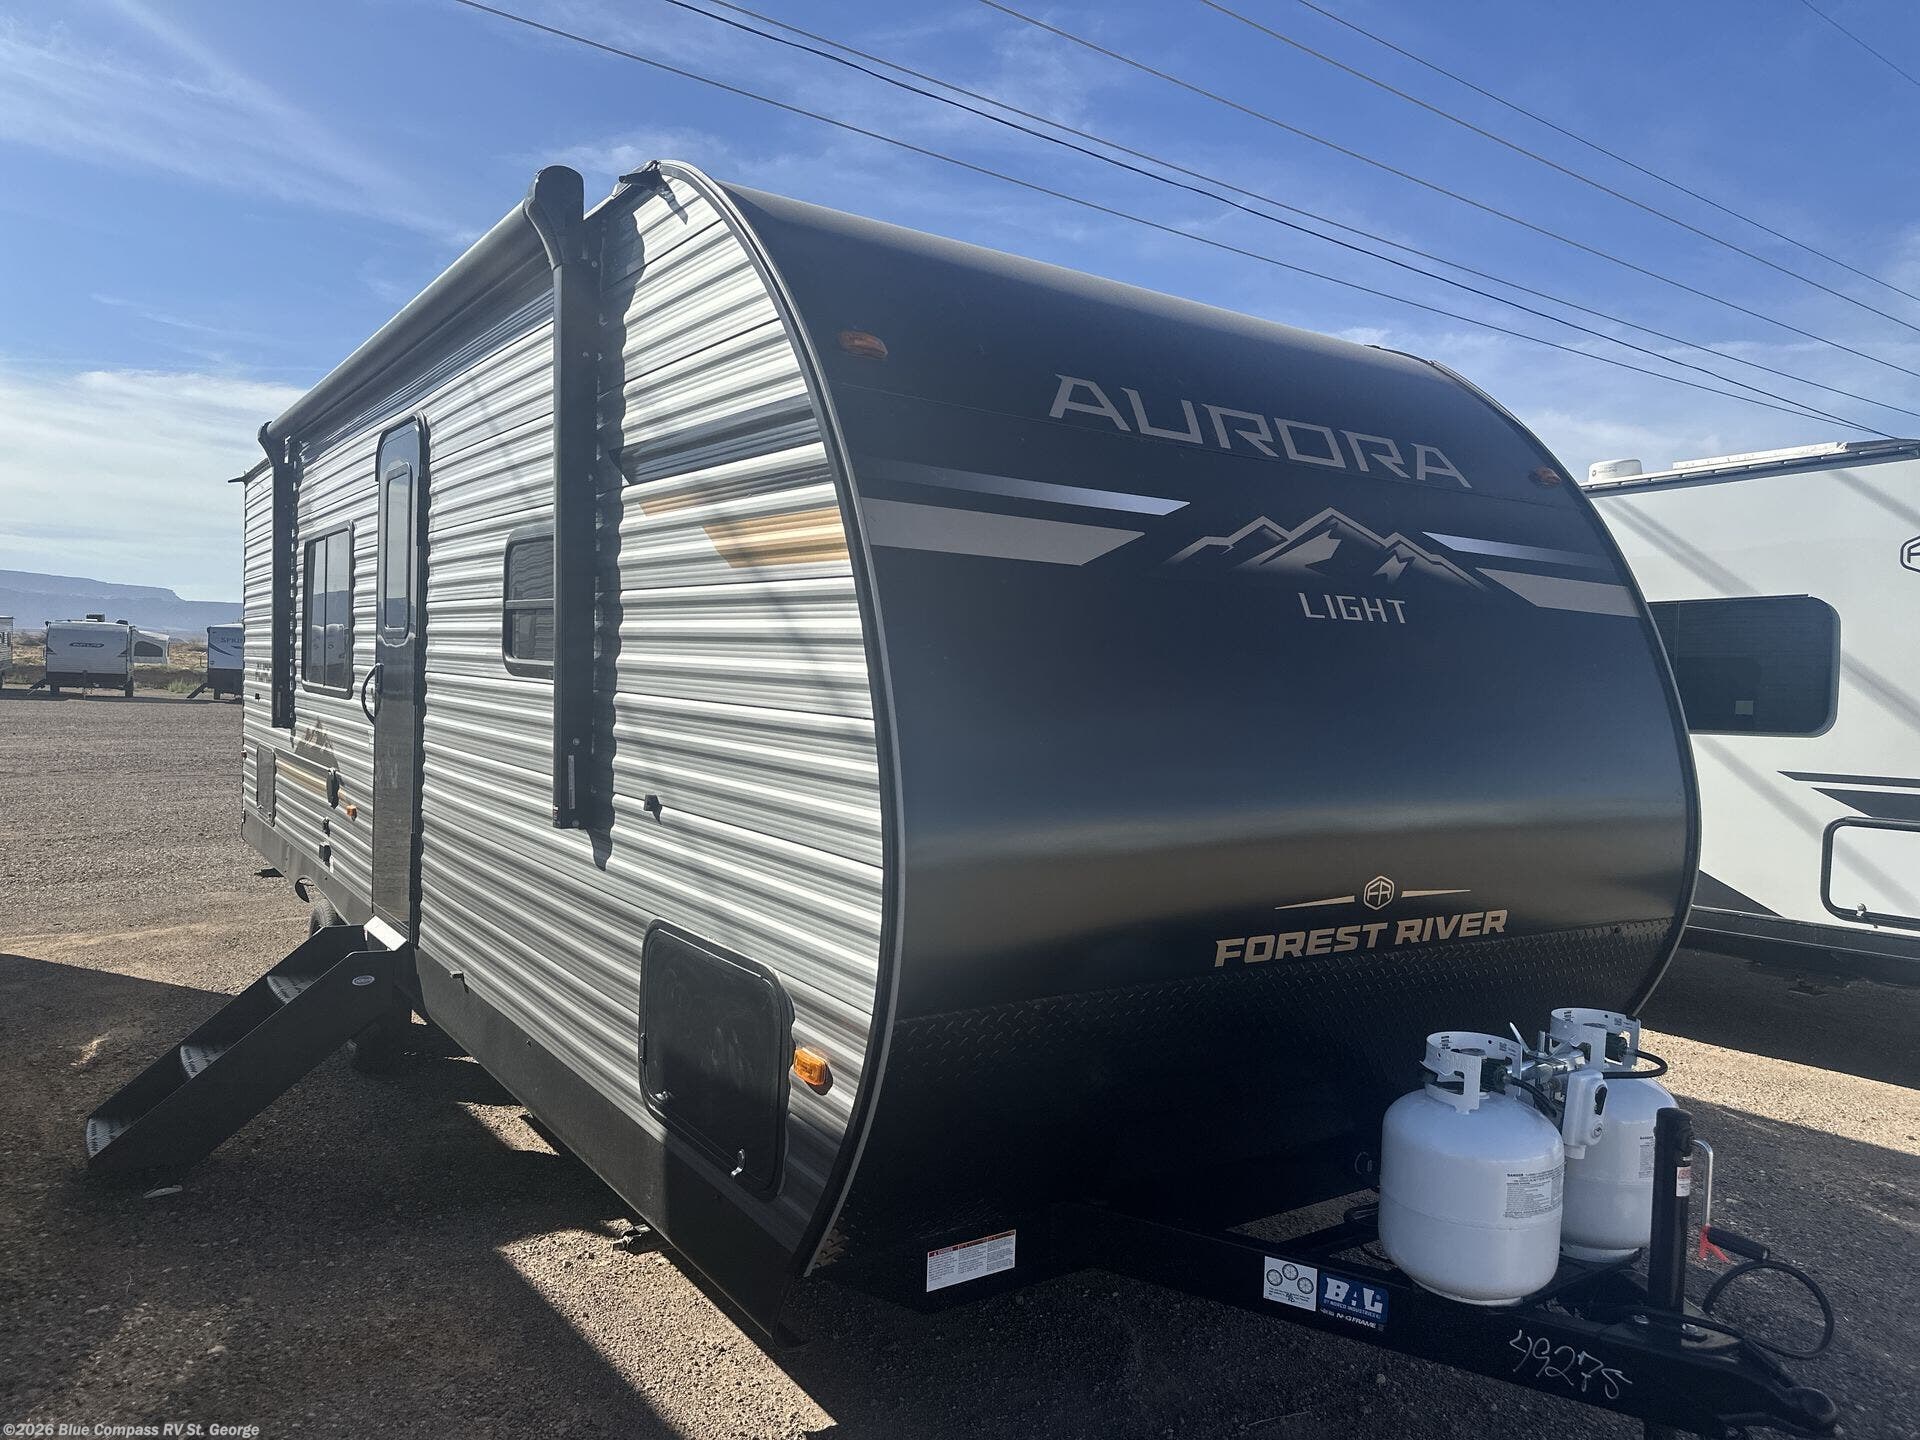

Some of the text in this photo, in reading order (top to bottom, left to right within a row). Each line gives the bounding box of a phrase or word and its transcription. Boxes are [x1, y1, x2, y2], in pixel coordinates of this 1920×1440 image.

[1048, 373, 1473, 488] AURORA
[1298, 592, 1406, 624] LIGHT
[1214, 909, 1508, 968] FOREST RIVER
[1324, 1277, 1384, 1314] BAL
[1509, 1329, 1633, 1400] 49275
